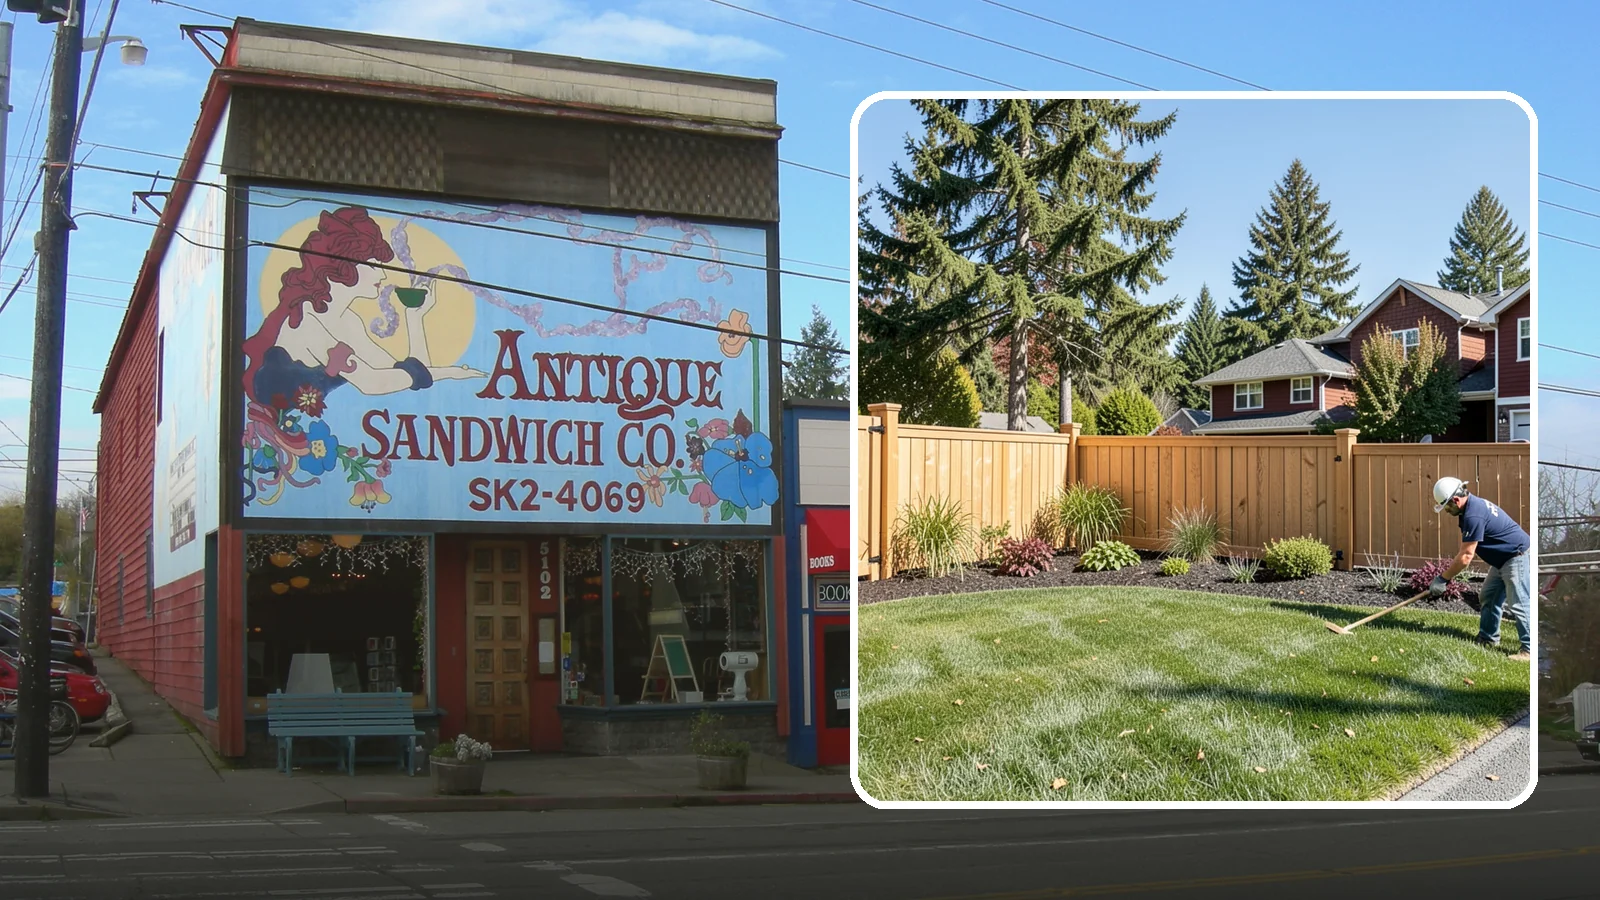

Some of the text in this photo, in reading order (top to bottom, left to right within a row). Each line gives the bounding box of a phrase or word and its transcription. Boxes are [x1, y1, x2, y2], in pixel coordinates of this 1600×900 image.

[477, 329, 722, 420] ANTIQUE
[361, 408, 685, 468] SANDWICH CO.
[468, 476, 645, 513] SK2-4069
[540, 541, 551, 600] 5102
[809, 555, 835, 569] BOOKS
